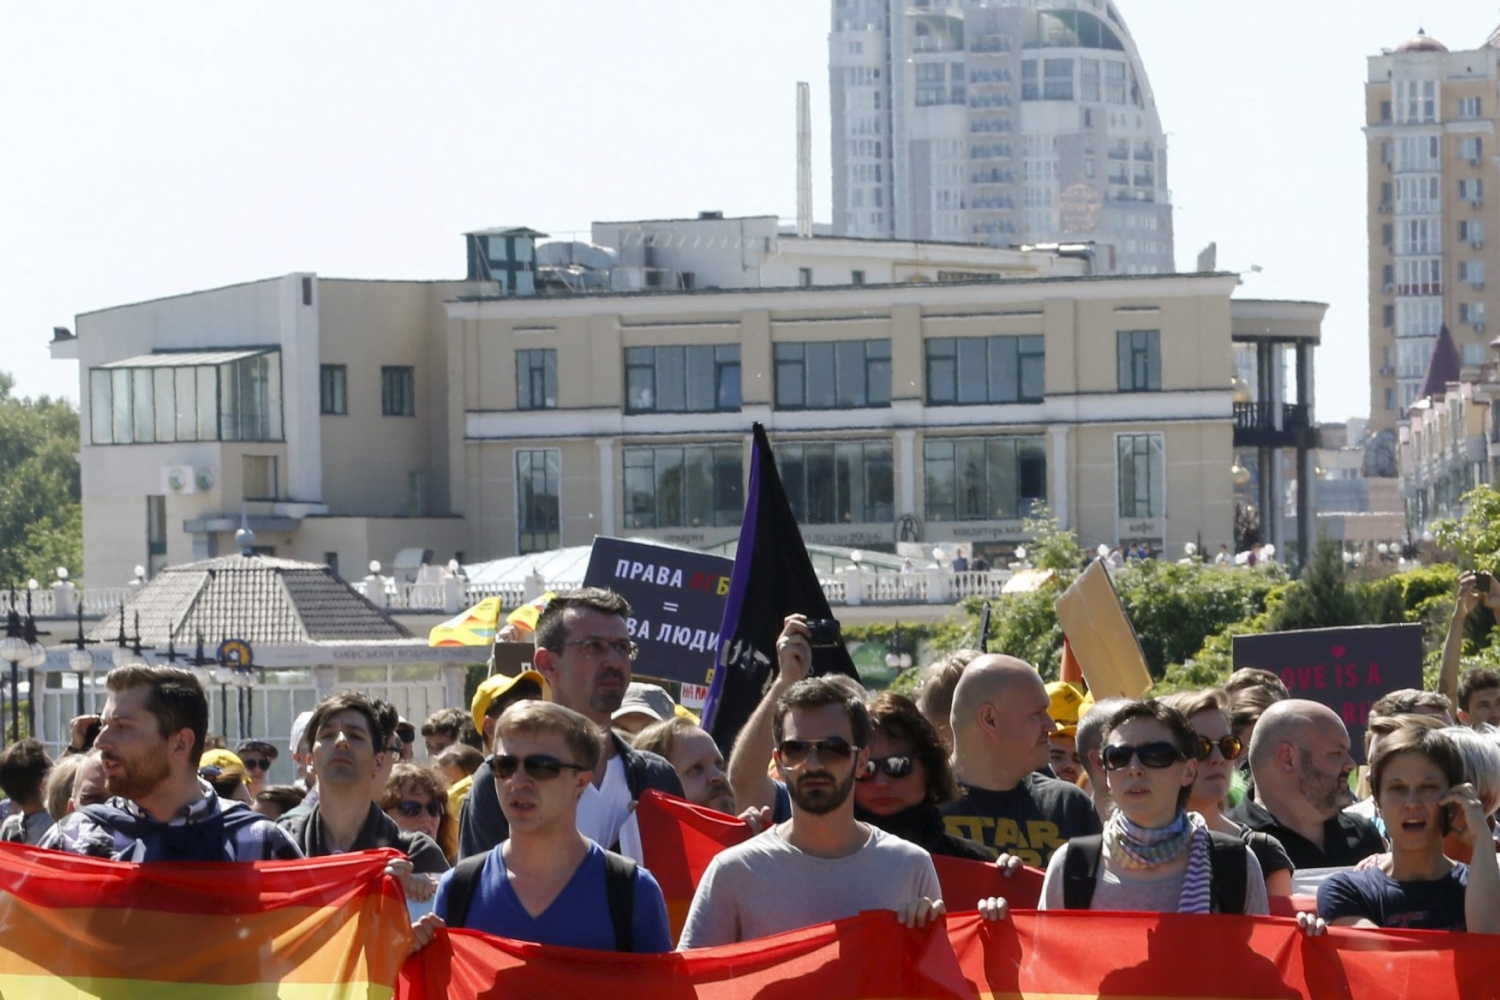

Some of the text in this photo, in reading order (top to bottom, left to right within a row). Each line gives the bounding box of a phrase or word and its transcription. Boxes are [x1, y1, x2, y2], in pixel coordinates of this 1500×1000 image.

[614, 559, 730, 596] ПРАВА ЛГБ
[626, 617, 720, 653] ВА ЛЮДИ
[1268, 661, 1382, 692] OVE IS A
[942, 815, 1068, 849] STAR
